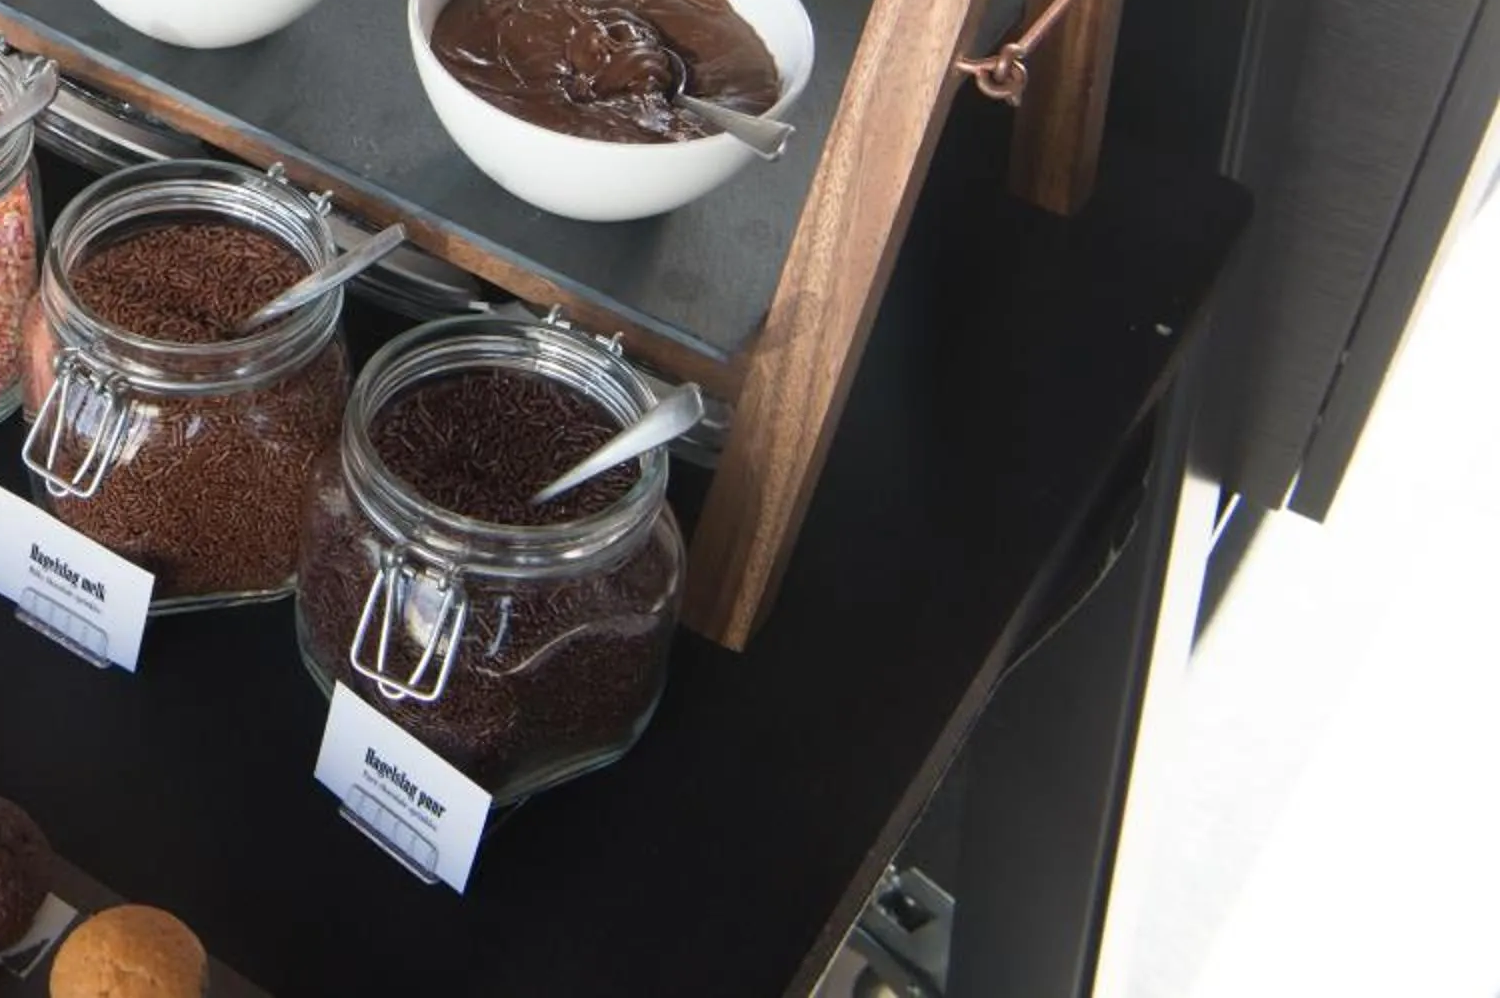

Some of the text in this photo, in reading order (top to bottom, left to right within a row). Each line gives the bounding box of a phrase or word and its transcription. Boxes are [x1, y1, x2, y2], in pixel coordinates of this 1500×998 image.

[29, 542, 80, 589] Hagelslag
[81, 578, 107, 603] melk
[364, 746, 419, 800] Hagelslag
